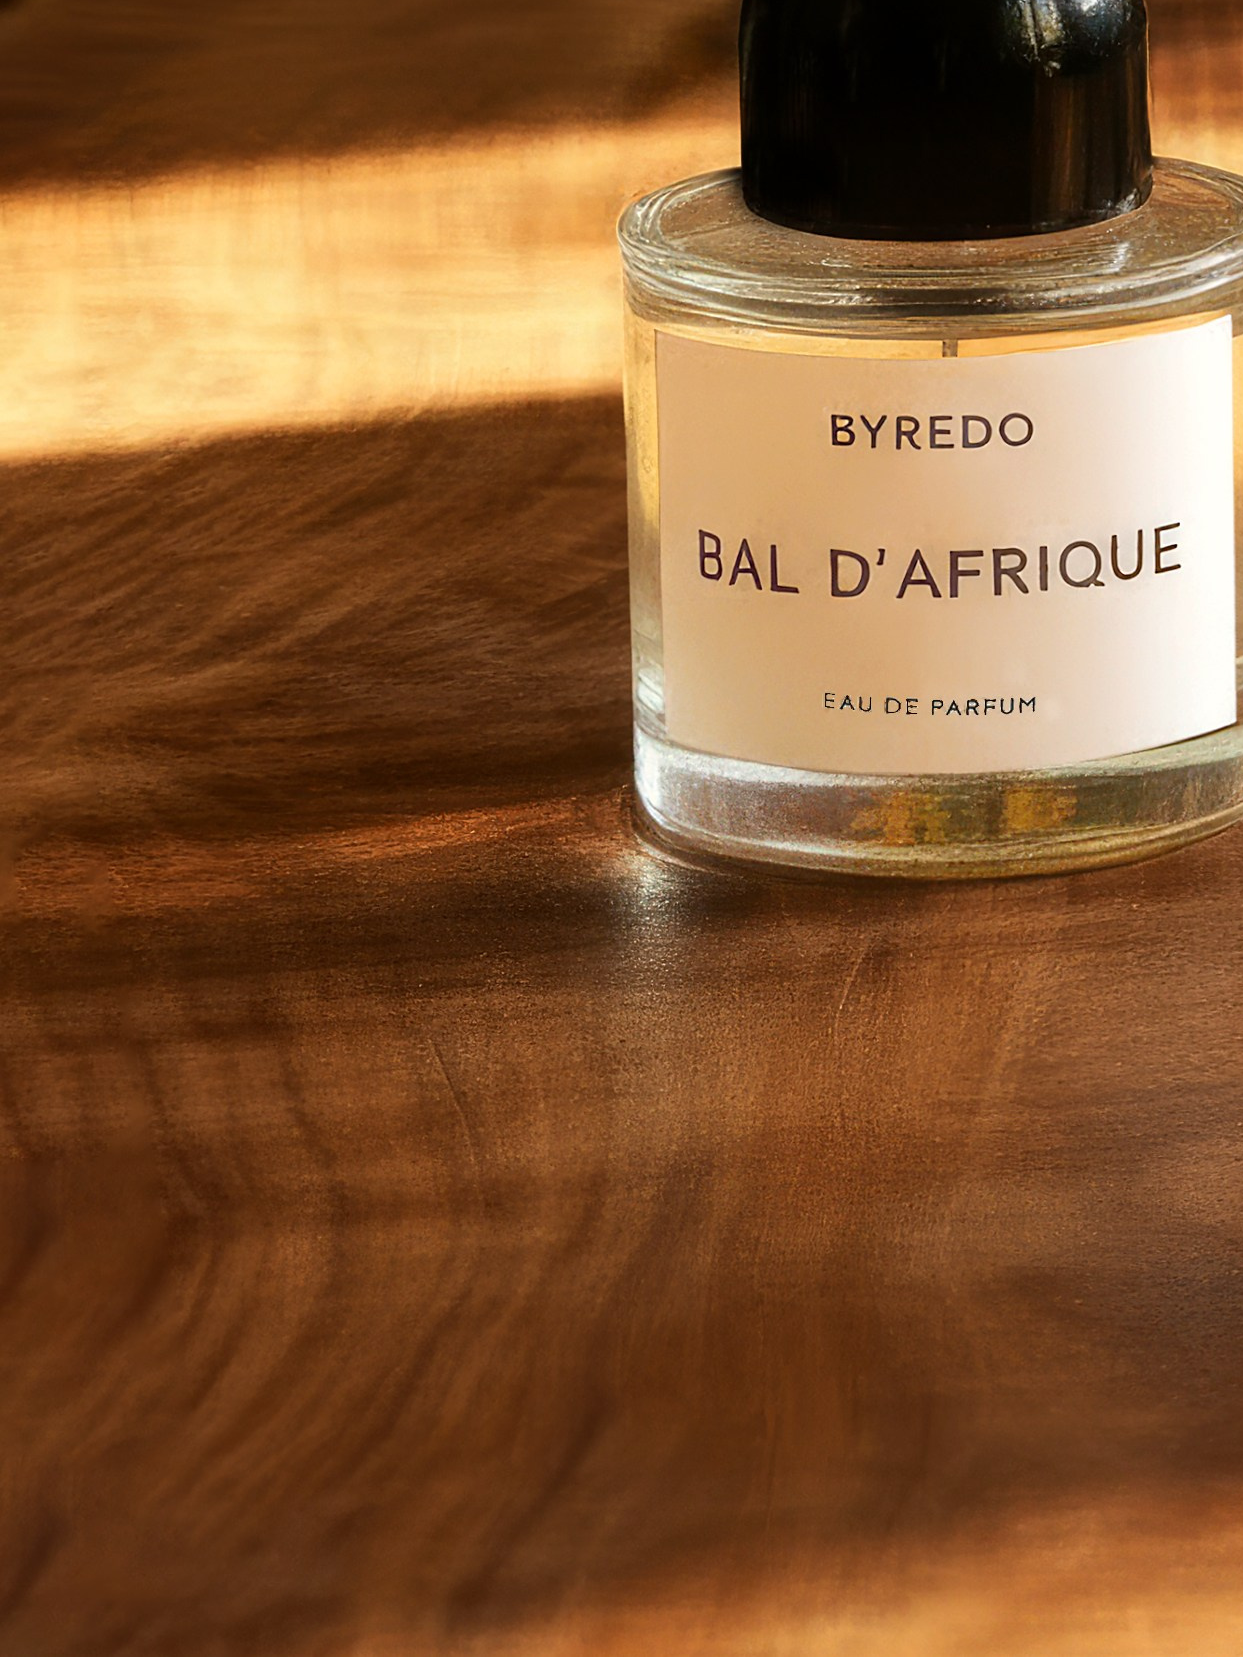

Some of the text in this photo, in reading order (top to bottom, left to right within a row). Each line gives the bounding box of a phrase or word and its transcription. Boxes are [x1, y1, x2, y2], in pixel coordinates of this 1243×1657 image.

[830, 412, 1034, 451] BYREDO
[698, 521, 1182, 600] BAL D'AFRIQUE
[823, 692, 1037, 716] EAU DE PARFUM
